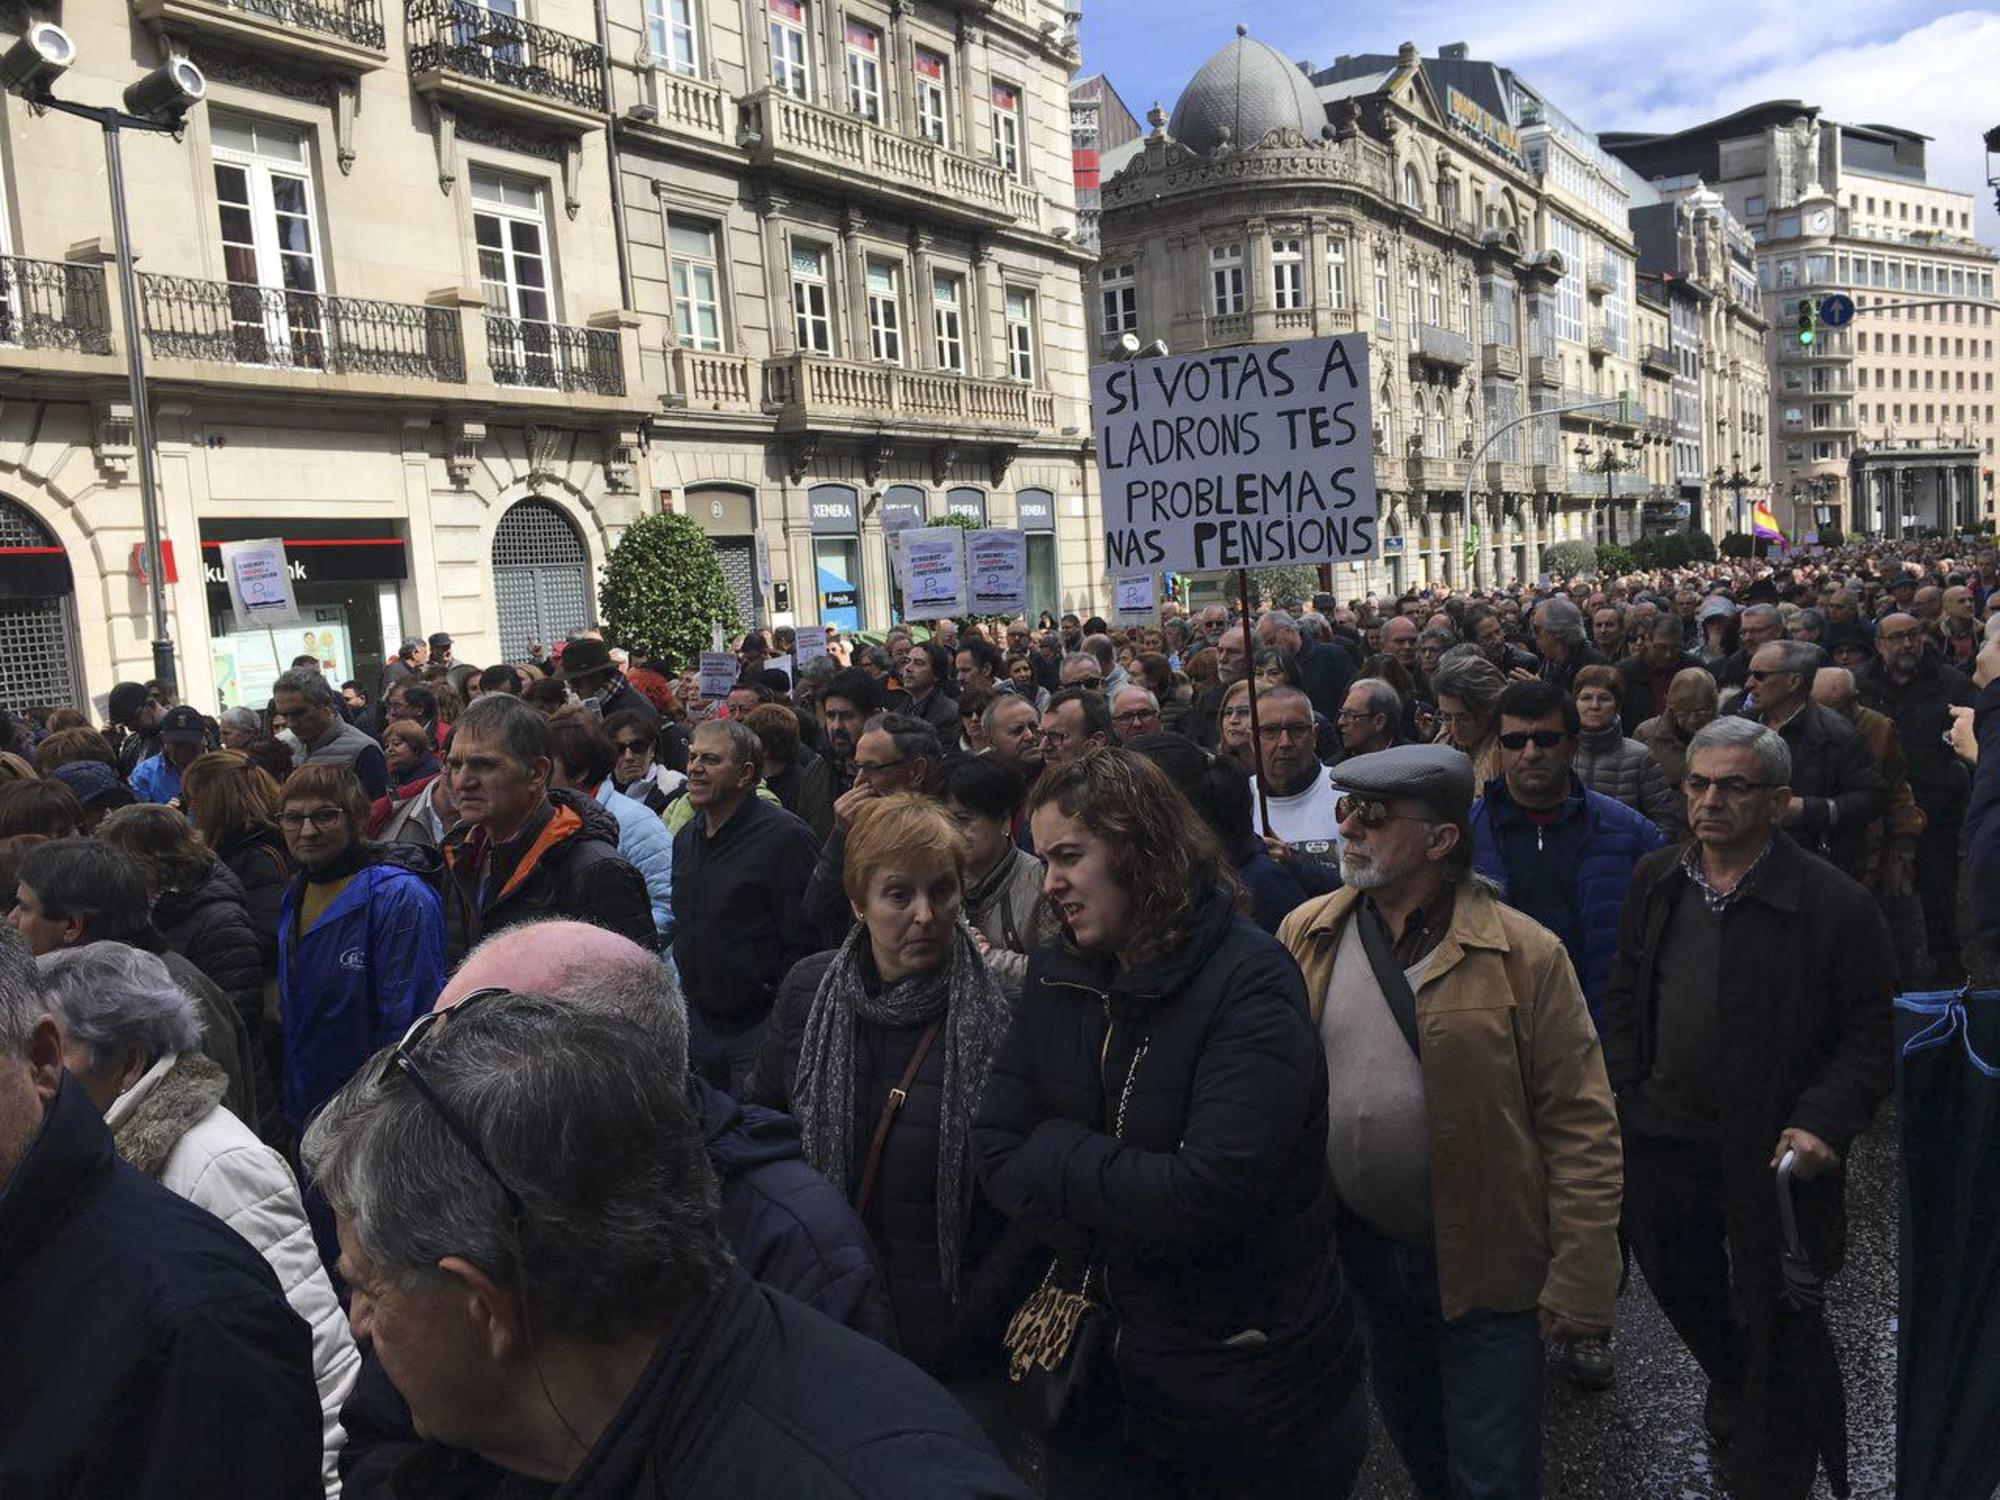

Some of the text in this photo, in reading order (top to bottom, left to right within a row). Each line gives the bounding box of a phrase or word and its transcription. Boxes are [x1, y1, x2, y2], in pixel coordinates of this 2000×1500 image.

[1153, 347, 1295, 408] VOTAS
[1318, 339, 1358, 392] A
[1104, 402, 1357, 469] LADRONS TES
[813, 504, 852, 517] XENERA
[1126, 467, 1356, 524] PROBLEMAS
[1106, 514, 1375, 570] NAS PENSIONS
